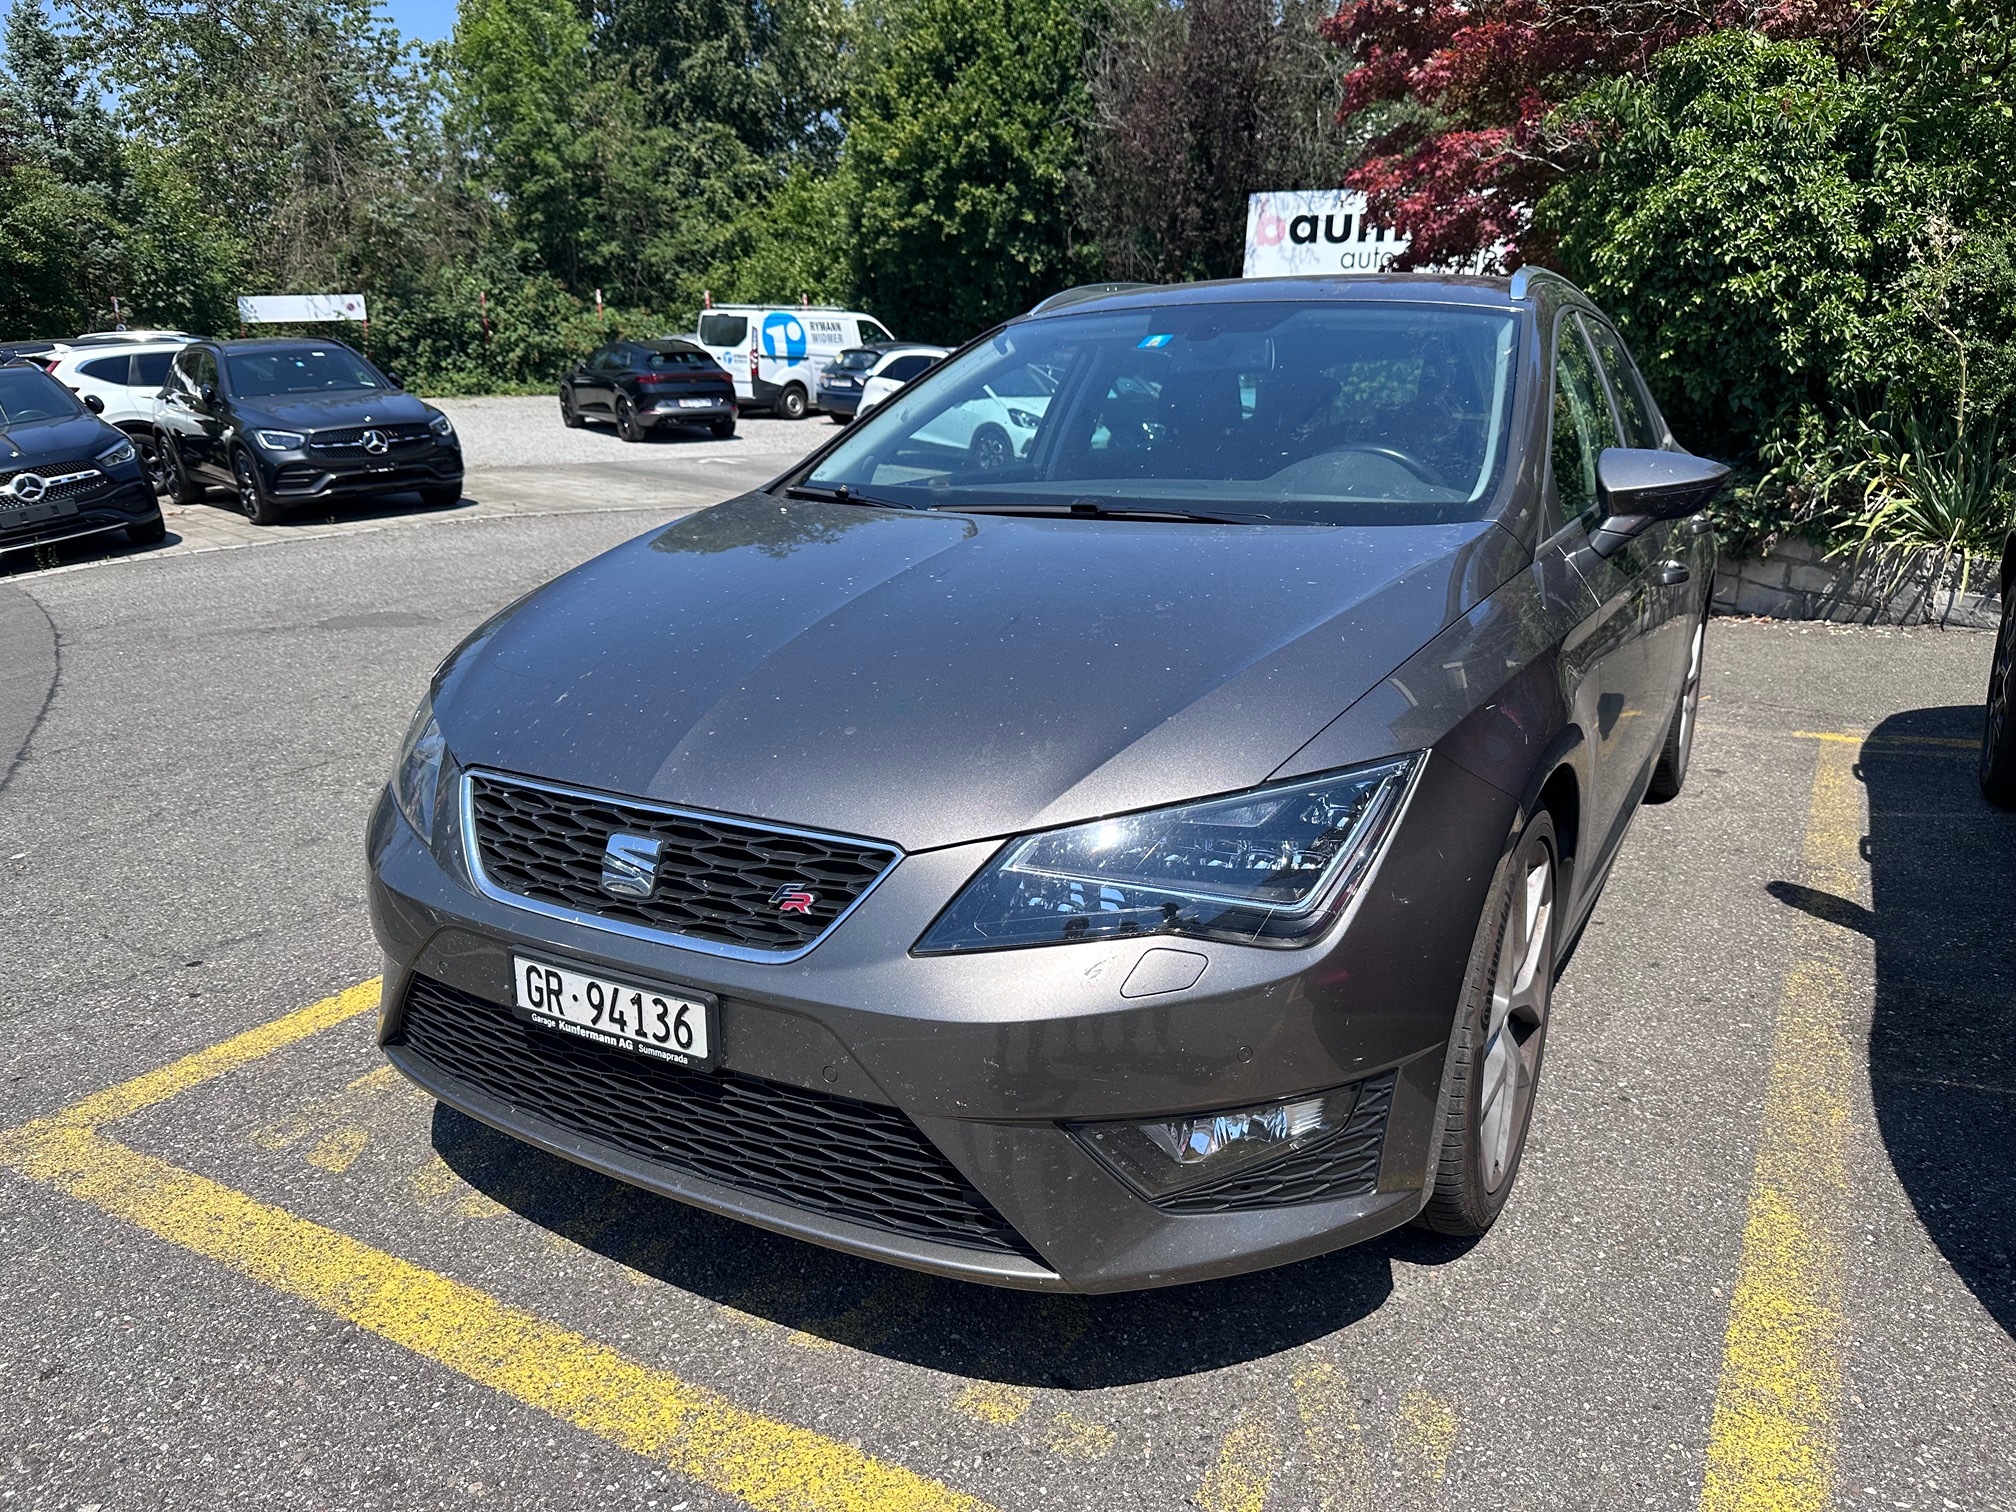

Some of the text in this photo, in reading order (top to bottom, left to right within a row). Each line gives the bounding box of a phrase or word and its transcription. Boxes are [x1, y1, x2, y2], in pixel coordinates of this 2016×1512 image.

[809, 321, 842, 332] RYMANN
[811, 333, 844, 344] WIDMER
[531, 1012, 689, 1065] Garage Kunfermann AG Summaprada
